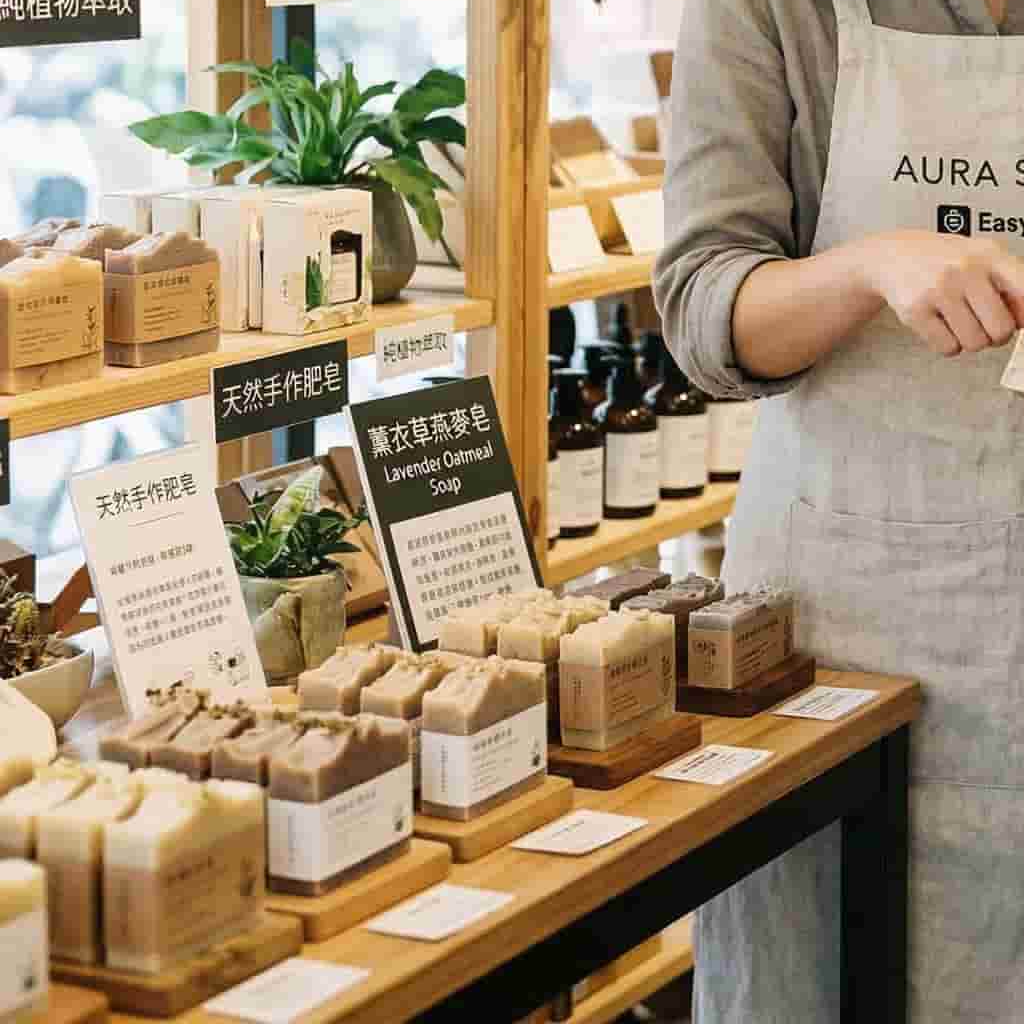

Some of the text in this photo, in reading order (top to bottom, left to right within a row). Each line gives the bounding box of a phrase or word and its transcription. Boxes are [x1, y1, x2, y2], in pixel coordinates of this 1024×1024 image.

[893, 154, 999, 187] AURA
[222, 361, 342, 417] 天然手作肥皂
[368, 403, 491, 459] 薰衣草燕麥皂
[384, 441, 494, 483] Lavender Oatmeal
[96, 472, 199, 520] 天然手作肥皂
[430, 477, 462, 496] Soap
